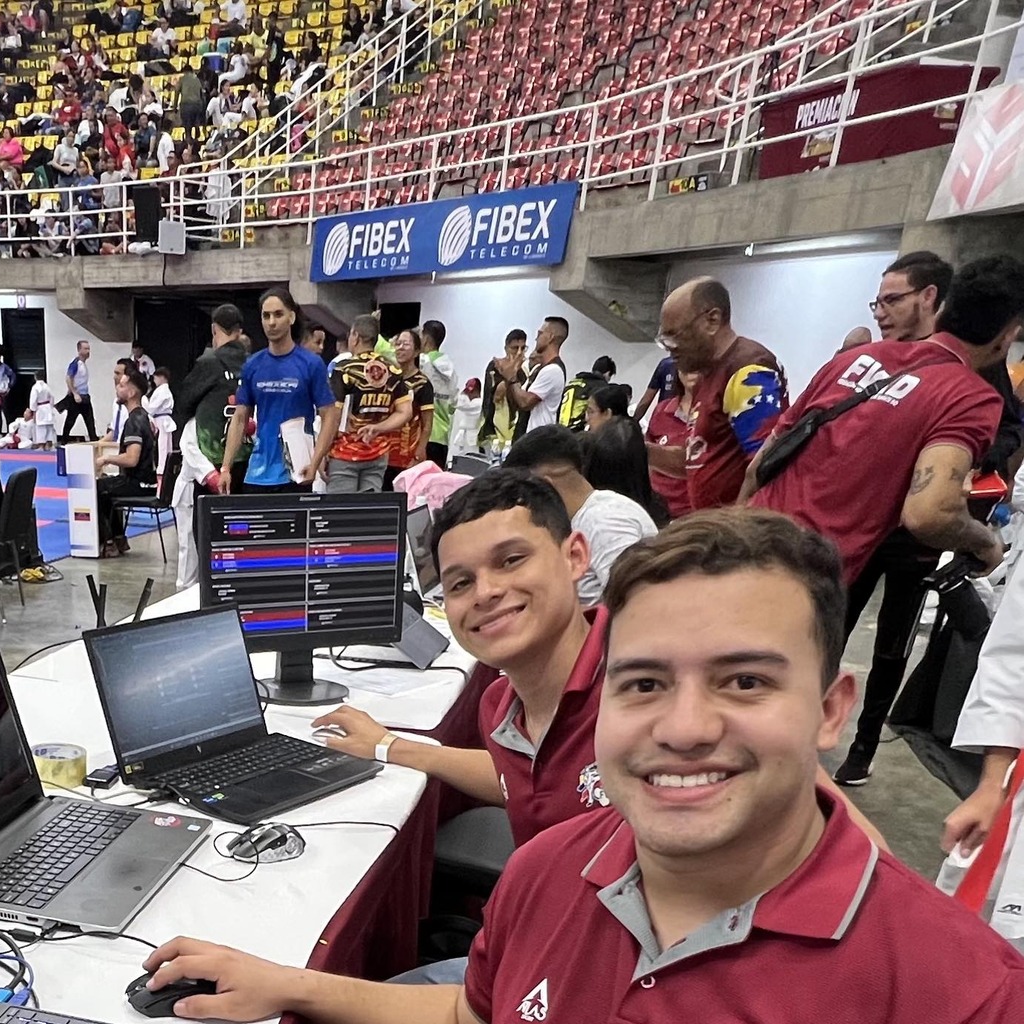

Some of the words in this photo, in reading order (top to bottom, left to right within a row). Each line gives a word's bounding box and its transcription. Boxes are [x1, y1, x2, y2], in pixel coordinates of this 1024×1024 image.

[349, 218, 415, 258] FIBEX
[471, 199, 557, 246] FIBEX
[347, 256, 410, 271] TELECOM
[470, 243, 549, 260] TELECOM
